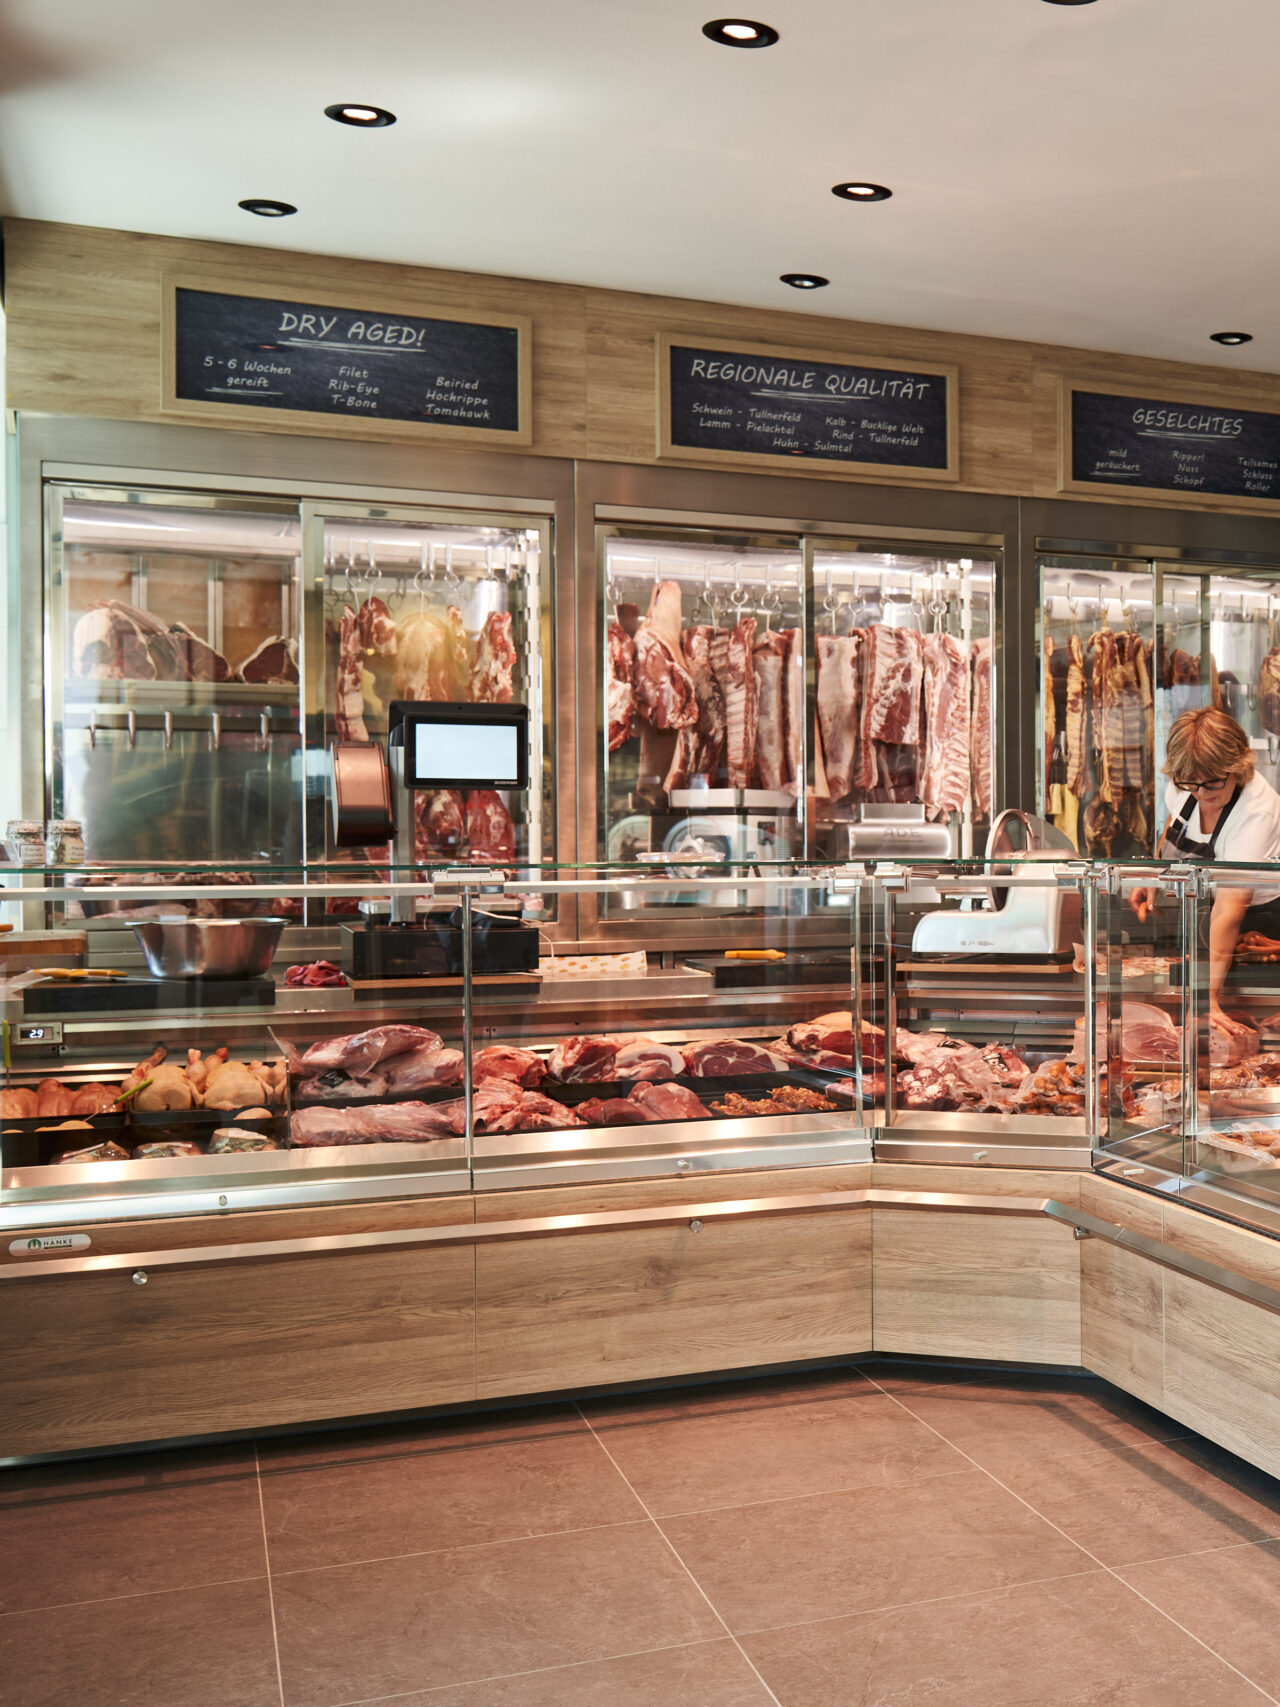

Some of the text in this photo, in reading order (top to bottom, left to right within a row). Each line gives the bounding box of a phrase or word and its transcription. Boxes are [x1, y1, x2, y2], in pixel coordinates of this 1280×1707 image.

[278, 312, 426, 347] DRY AGED!
[203, 355, 214, 367] 5
[227, 358, 238, 370] 6
[243, 359, 292, 375] Wochen
[338, 366, 369, 378] Filet
[226, 376, 270, 389] gereift
[328, 379, 380, 396] Rib-Eye
[435, 376, 480, 390] Beiried
[690, 359, 930, 400] REGIONALE QUALITÄT
[331, 394, 378, 409] T-Bone
[425, 389, 489, 406] Hochrippe
[425, 404, 491, 420] Tomahawk
[691, 402, 733, 416] Schwein
[749, 407, 802, 423] Tullnerfeld
[699, 417, 731, 430] Lamm
[746, 421, 795, 435] Pielachtal
[825, 416, 846, 427] Kalb
[860, 419, 898, 433] Bucklige
[902, 423, 925, 435] Welt
[1132, 408, 1244, 436] GESELCHTES
[773, 437, 799, 449] Huhn
[814, 440, 852, 453] Sulmtal
[832, 429, 854, 441] Rind
[869, 432, 919, 447] Tullnerfeld
[1109, 449, 1128, 458] mild
[1172, 450, 1205, 463] Ripperl
[1095, 461, 1141, 472] geräuchert
[1178, 463, 1199, 473] Nuss
[1173, 474, 1205, 487] Schopf
[1245, 481, 1271, 493] Roller
